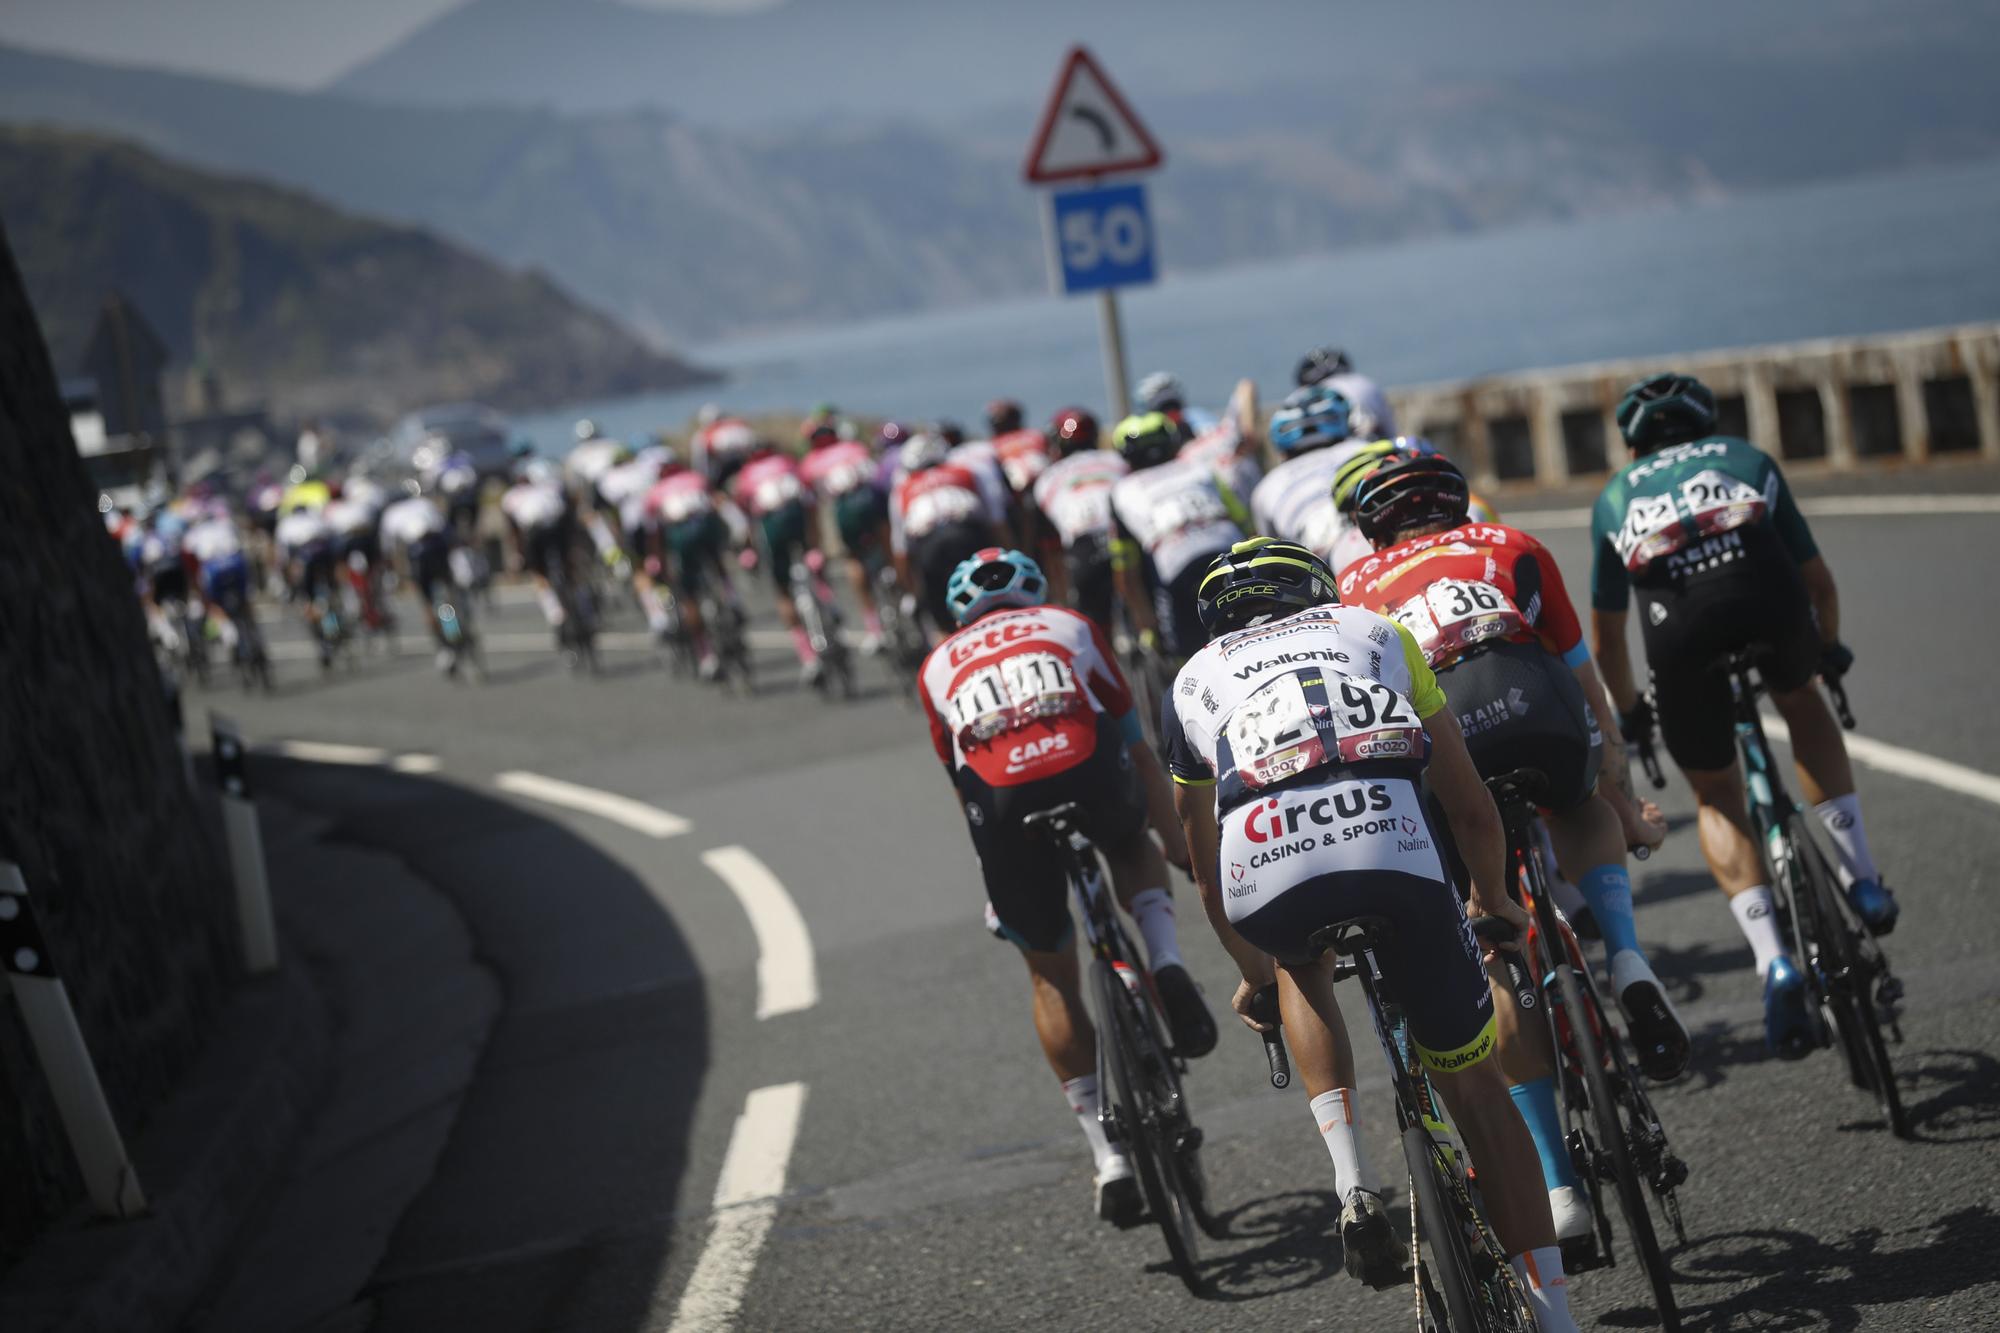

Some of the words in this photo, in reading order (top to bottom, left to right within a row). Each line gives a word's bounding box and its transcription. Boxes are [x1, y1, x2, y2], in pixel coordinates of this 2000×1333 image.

[1061, 206, 1147, 273] 50
[1215, 583, 1280, 609] FORCE
[1445, 584, 1499, 618] 36
[1227, 624, 1333, 656] MATERIAUX
[1233, 648, 1351, 681] Wallonie
[1340, 682, 1409, 729] 92
[1008, 732, 1069, 764] CAPS
[1244, 784, 1392, 844] Circus
[1250, 837, 1316, 869] CASINO
[1322, 832, 1336, 847] &
[1343, 818, 1398, 841] SPORT
[1397, 837, 1429, 853] Nalini
[1228, 880, 1257, 899] Nalini
[1428, 1034, 1490, 1070] Wallonie
